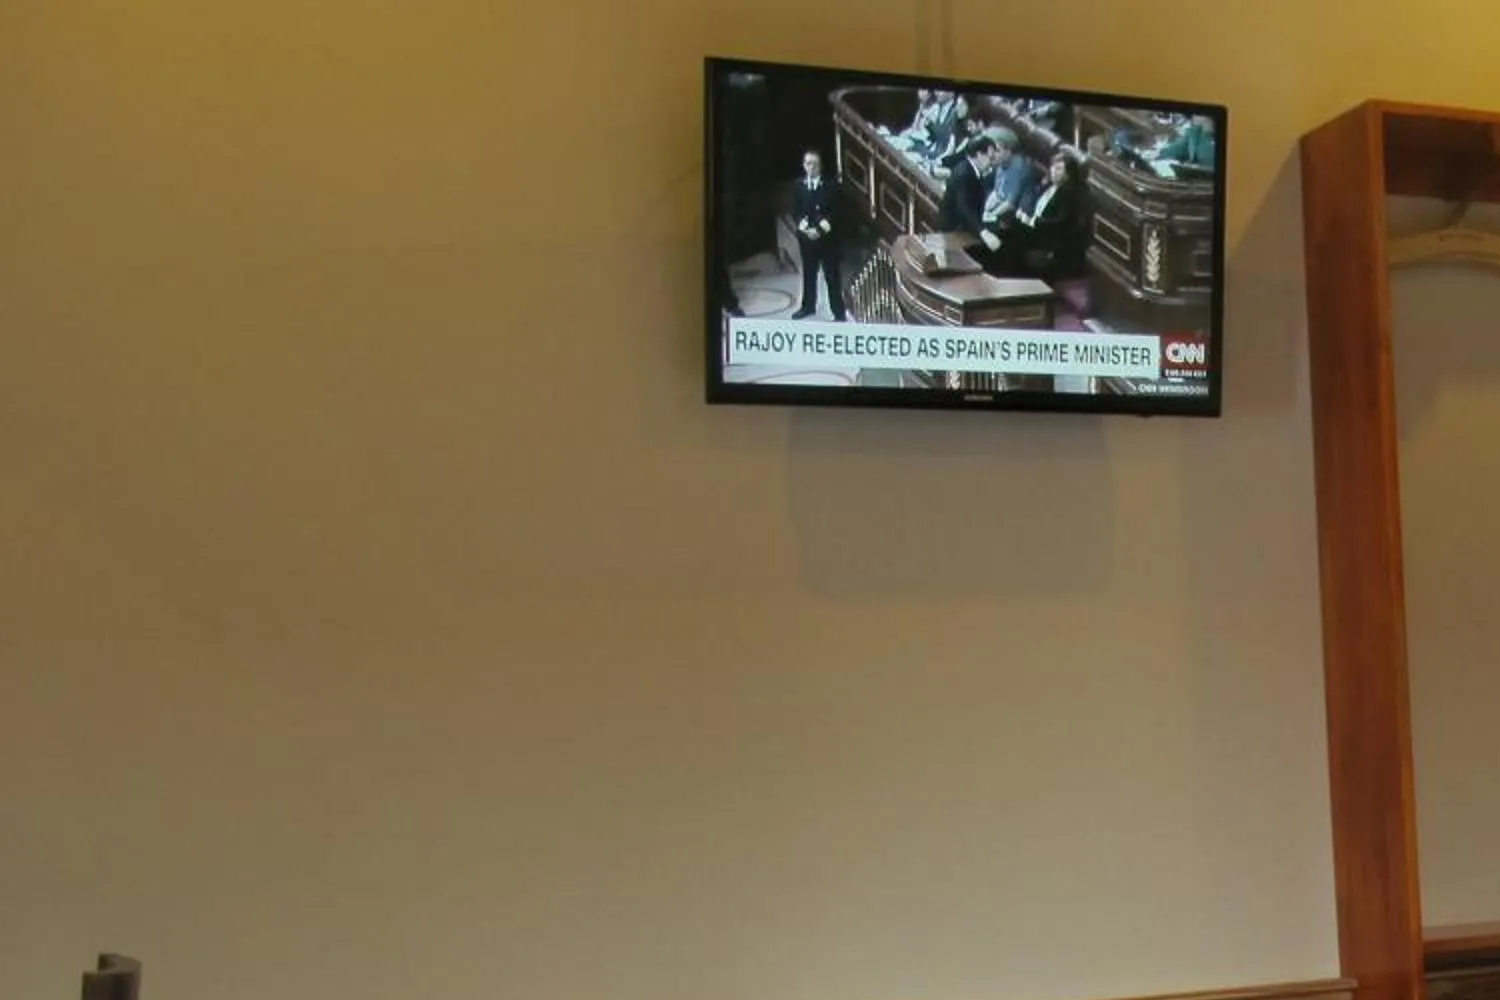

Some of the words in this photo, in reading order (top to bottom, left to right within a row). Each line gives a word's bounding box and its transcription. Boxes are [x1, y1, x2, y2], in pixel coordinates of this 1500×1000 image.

[736, 331, 797, 352] RAJOY
[803, 333, 911, 357] RE-ELECTED
[917, 337, 941, 358] AS
[945, 339, 1012, 362] SPAIN'S
[1017, 342, 1069, 363] PRIME
[1074, 345, 1151, 366] MINISTER
[1165, 342, 1205, 365] CNN
